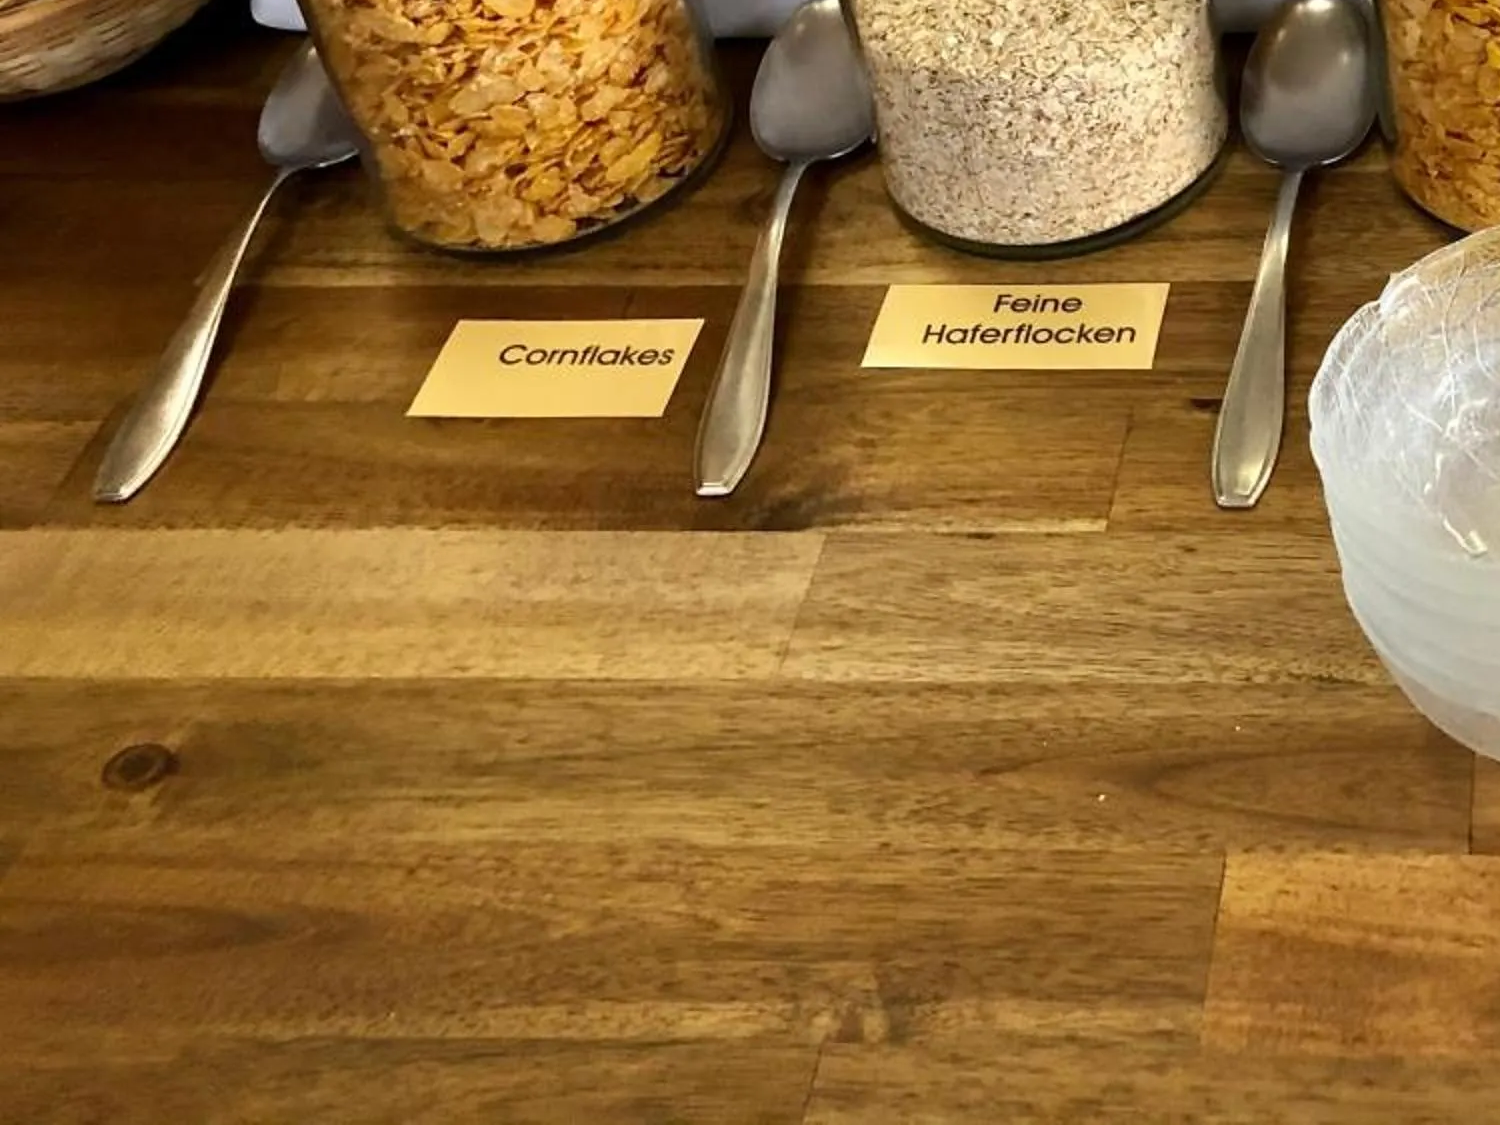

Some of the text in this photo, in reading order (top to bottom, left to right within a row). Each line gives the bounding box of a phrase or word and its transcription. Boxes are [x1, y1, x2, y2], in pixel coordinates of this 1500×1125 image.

[993, 293, 1084, 314] Feine
[922, 322, 1138, 346] Haferflocken
[498, 343, 676, 367] Cornflakes
